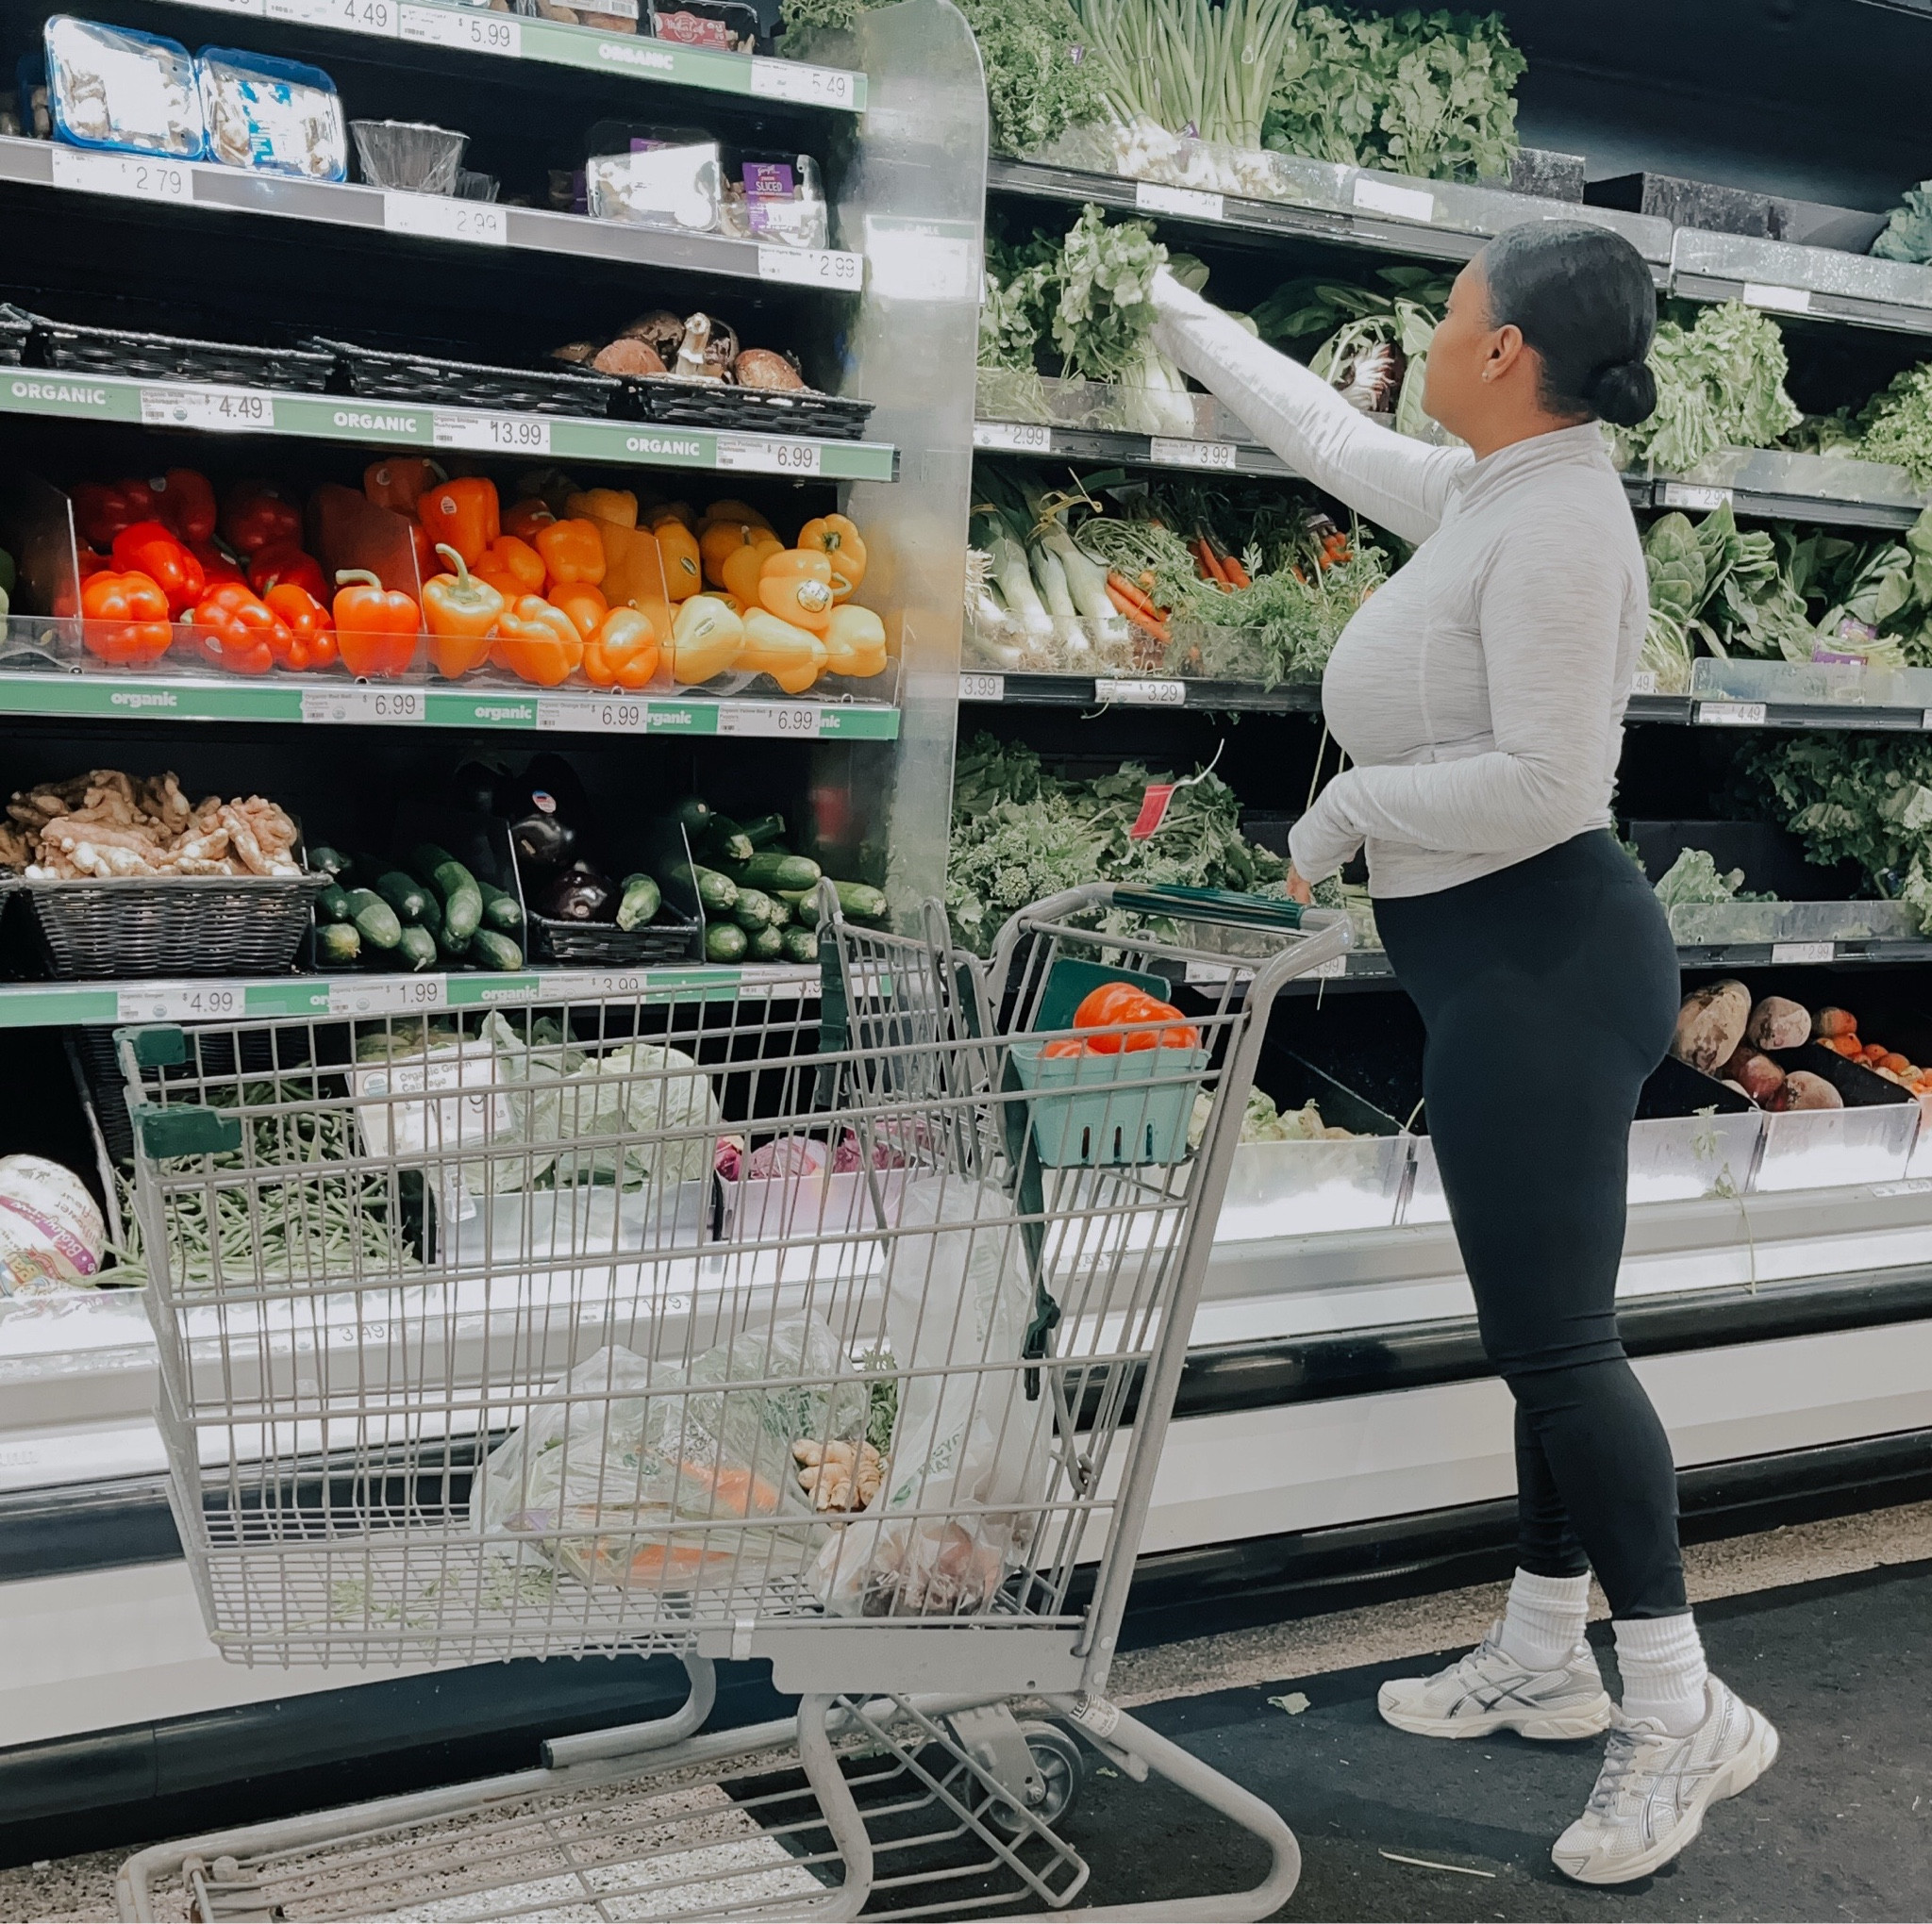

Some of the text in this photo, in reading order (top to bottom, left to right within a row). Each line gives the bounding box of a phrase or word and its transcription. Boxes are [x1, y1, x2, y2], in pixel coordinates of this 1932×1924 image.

[343, 0, 388, 27] 4.49
[471, 20, 510, 47] 5.99
[597, 42, 675, 71] ORGANIC
[812, 73, 846, 98] 549
[136, 165, 182, 195] 279
[755, 180, 783, 192] SLICED
[457, 209, 497, 235] 299
[820, 254, 855, 278] 299
[11, 381, 107, 406] ORGANIC
[218, 395, 264, 420] 4.49
[333, 411, 418, 434] ORGANIC
[493, 421, 541, 446] 13.99
[1012, 425, 1044, 446] 2.99
[625, 437, 701, 457] ORGANIC
[777, 446, 814, 469] 6.99
[1200, 445, 1228, 465] 3.99
[964, 676, 996, 697] 3.99
[1147, 684, 1178, 702] 3.29
[1631, 675, 1650, 691] .49
[110, 690, 178, 708] organic
[375, 694, 416, 716] 6.99
[475, 704, 532, 722] organic
[602, 705, 640, 726] 6.99
[647, 710, 692, 727] rganic
[777, 710, 813, 730] 6.99
[399, 983, 438, 1004] 1.99
[480, 984, 537, 1001] organic
[603, 977, 640, 991] 399
[190, 992, 234, 1014] 4.99
[399, 1067, 440, 1082] Organic
[402, 1078, 447, 1094] Cabage
[340, 1324, 385, 1342] 349
